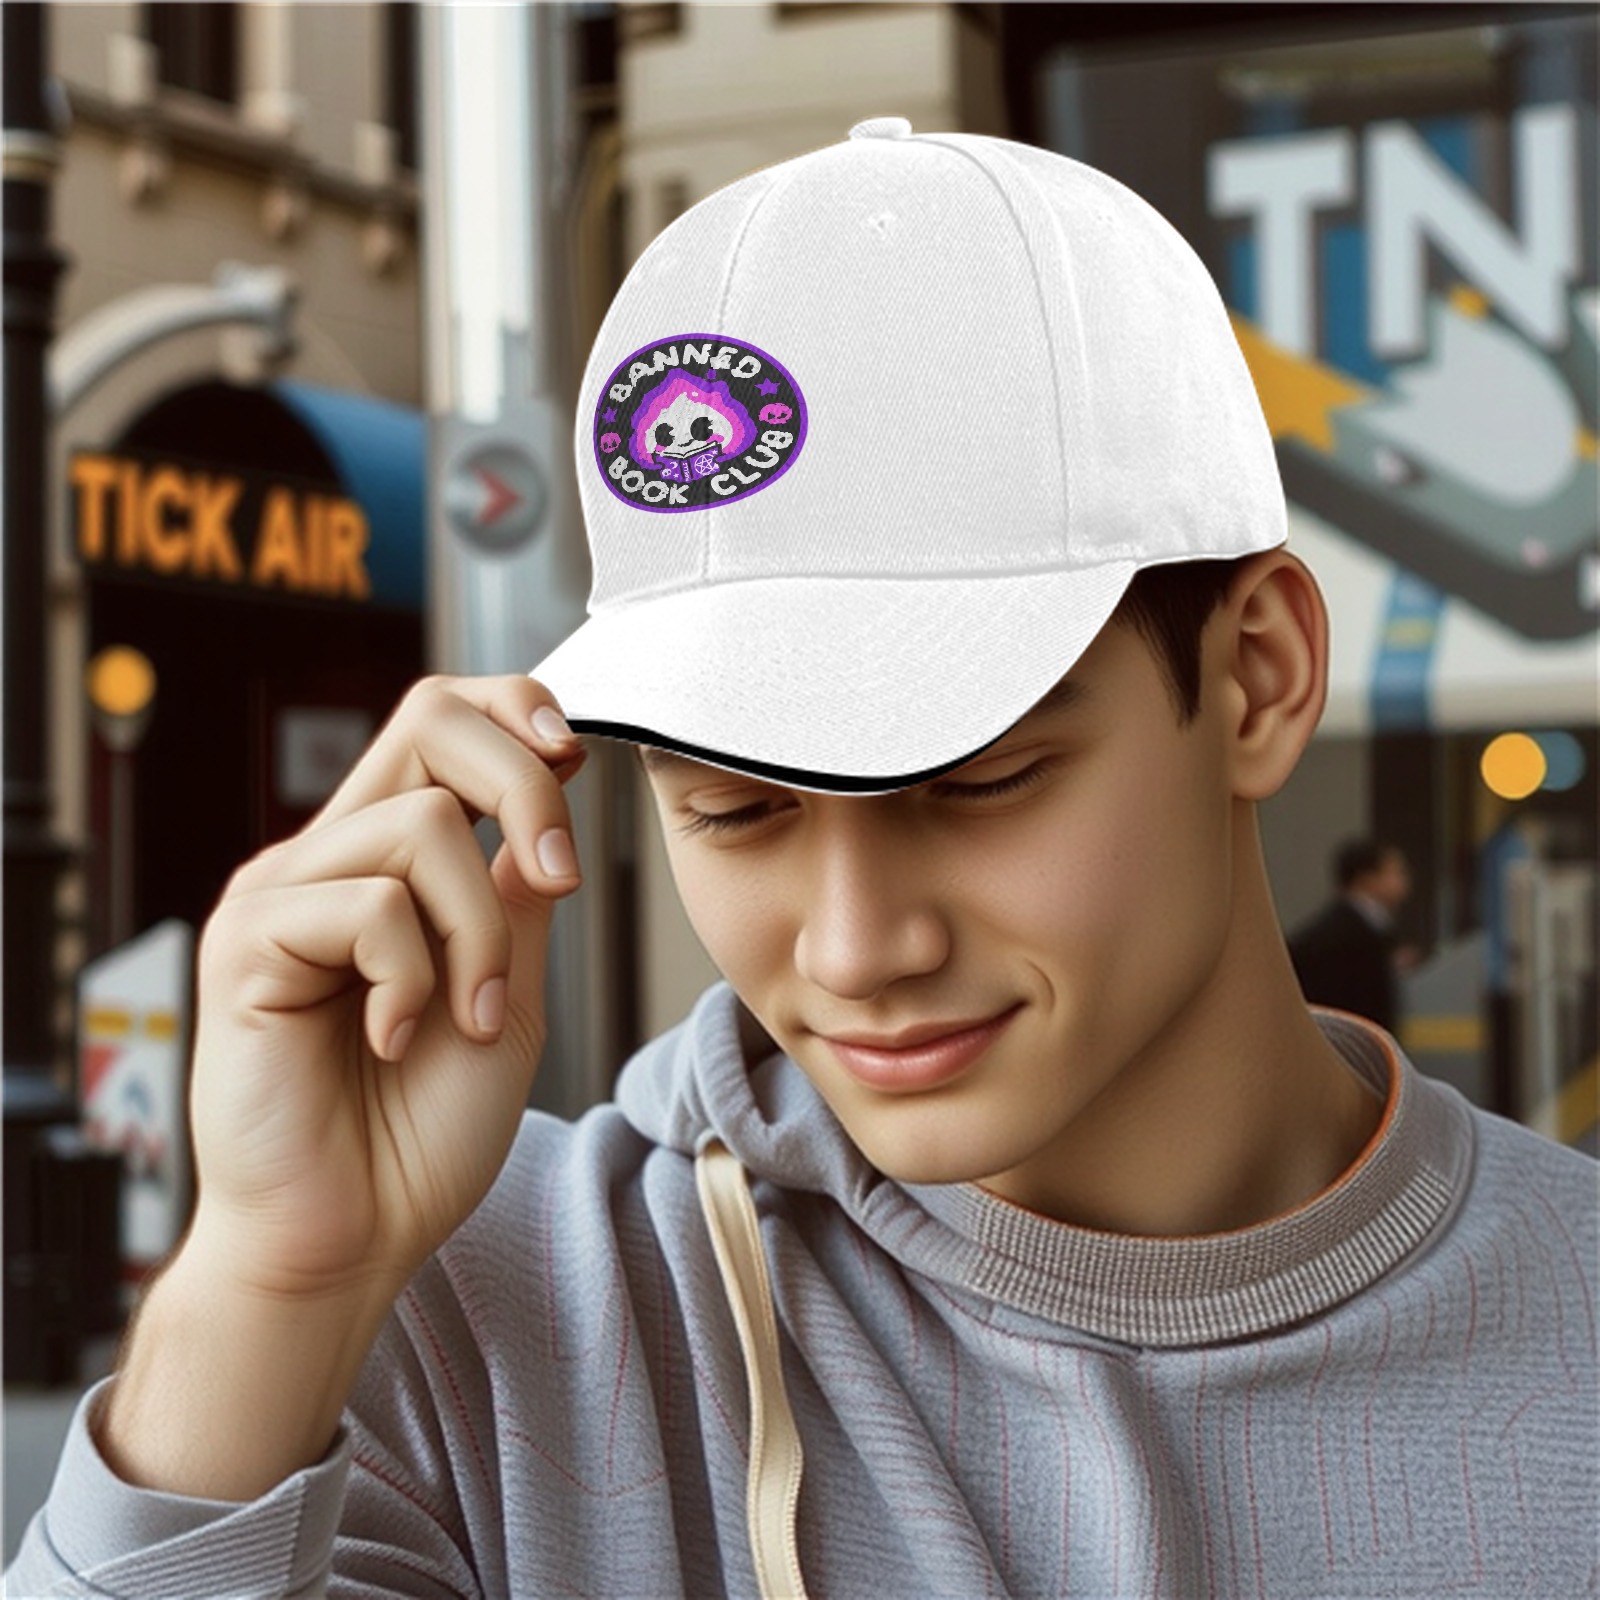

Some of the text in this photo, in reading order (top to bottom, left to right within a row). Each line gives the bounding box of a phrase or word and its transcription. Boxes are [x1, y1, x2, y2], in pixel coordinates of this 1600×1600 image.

[609, 343, 761, 402] BANNED
[608, 430, 793, 504] BOOK CLUB
[72, 456, 371, 602] TICK AIR
